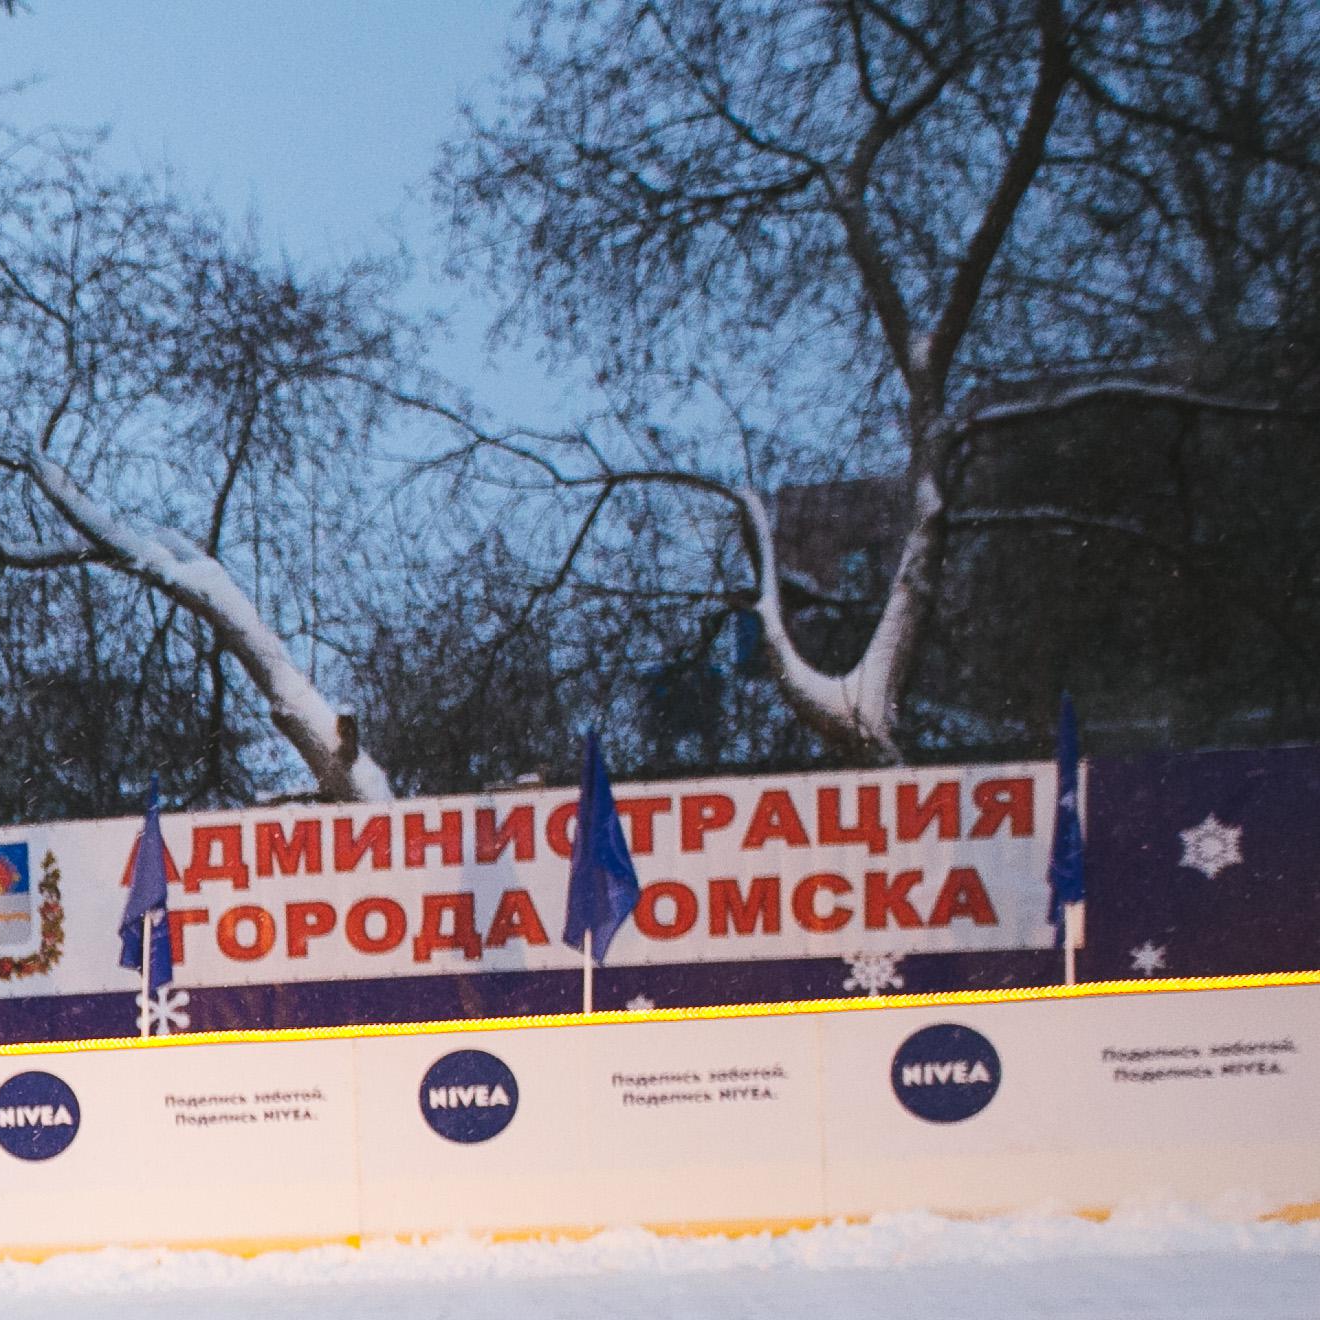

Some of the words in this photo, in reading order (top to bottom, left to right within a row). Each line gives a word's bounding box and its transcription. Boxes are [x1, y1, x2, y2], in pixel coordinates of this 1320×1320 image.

[166, 889, 549, 964] ГОРОДА
[633, 867, 999, 941] ОМСКА
[902, 1060, 992, 1087] NIVEA
[429, 1084, 510, 1109] NIVEA
